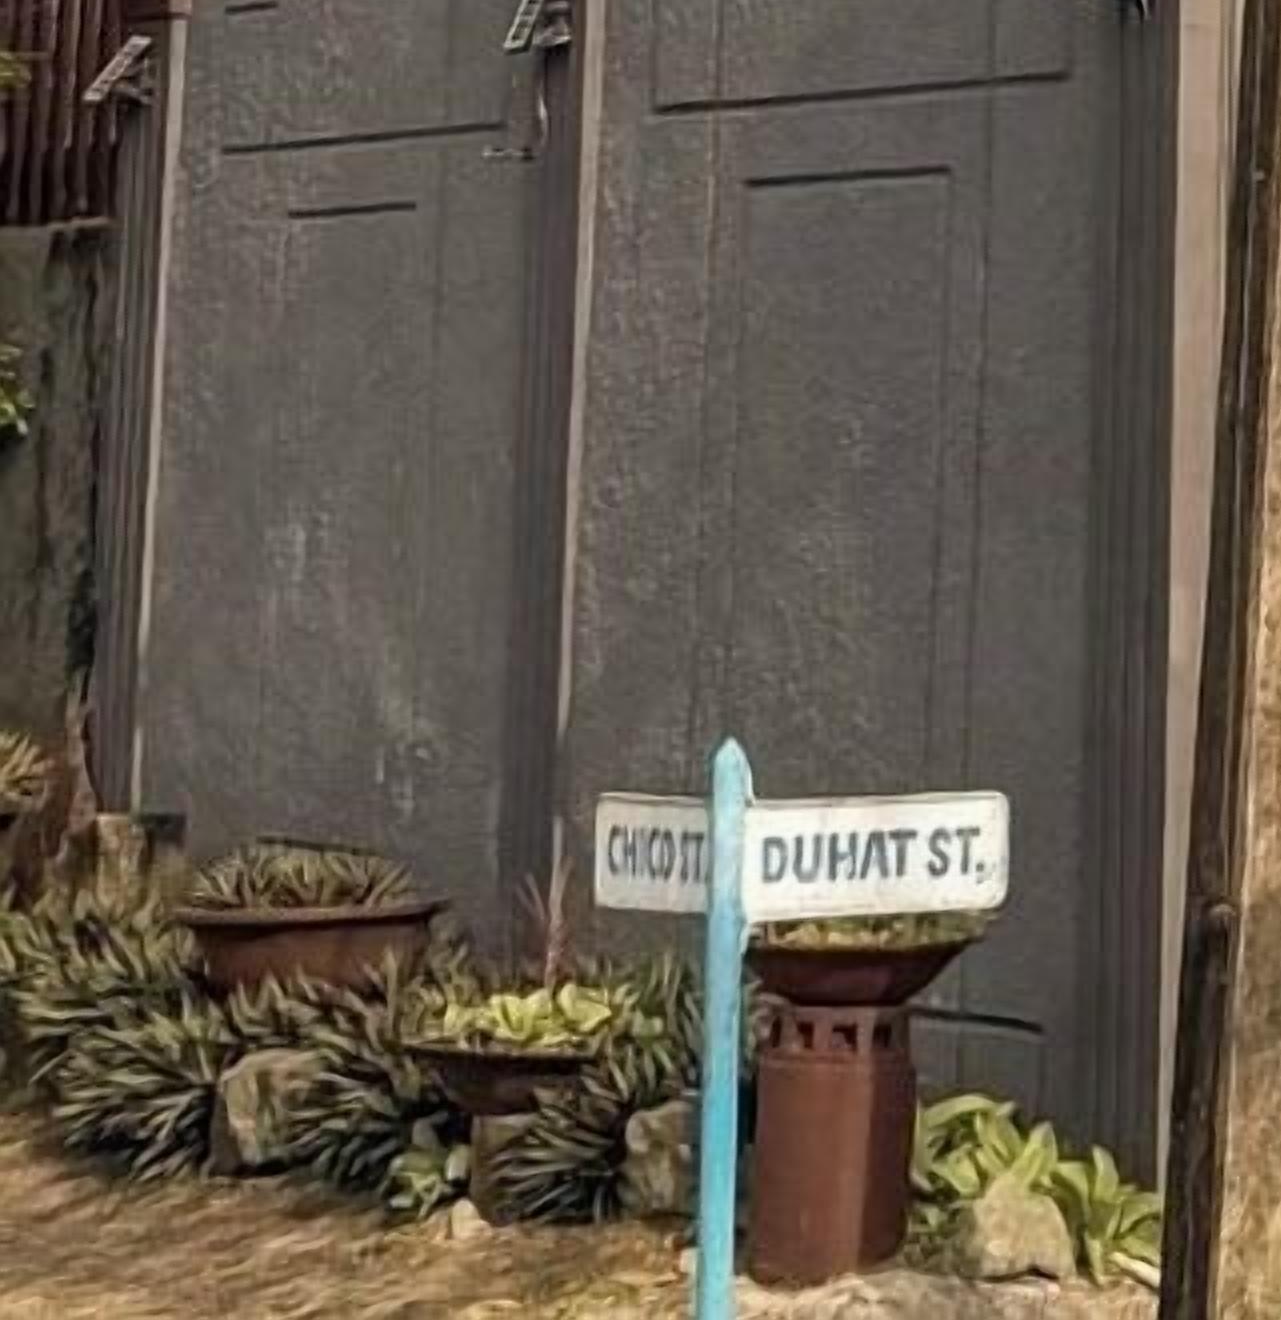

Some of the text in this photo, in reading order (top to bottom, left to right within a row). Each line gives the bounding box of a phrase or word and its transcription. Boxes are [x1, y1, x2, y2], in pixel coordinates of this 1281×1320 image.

[608, 825, 676, 882] CHICO
[761, 826, 985, 884] DUHAT ST.
